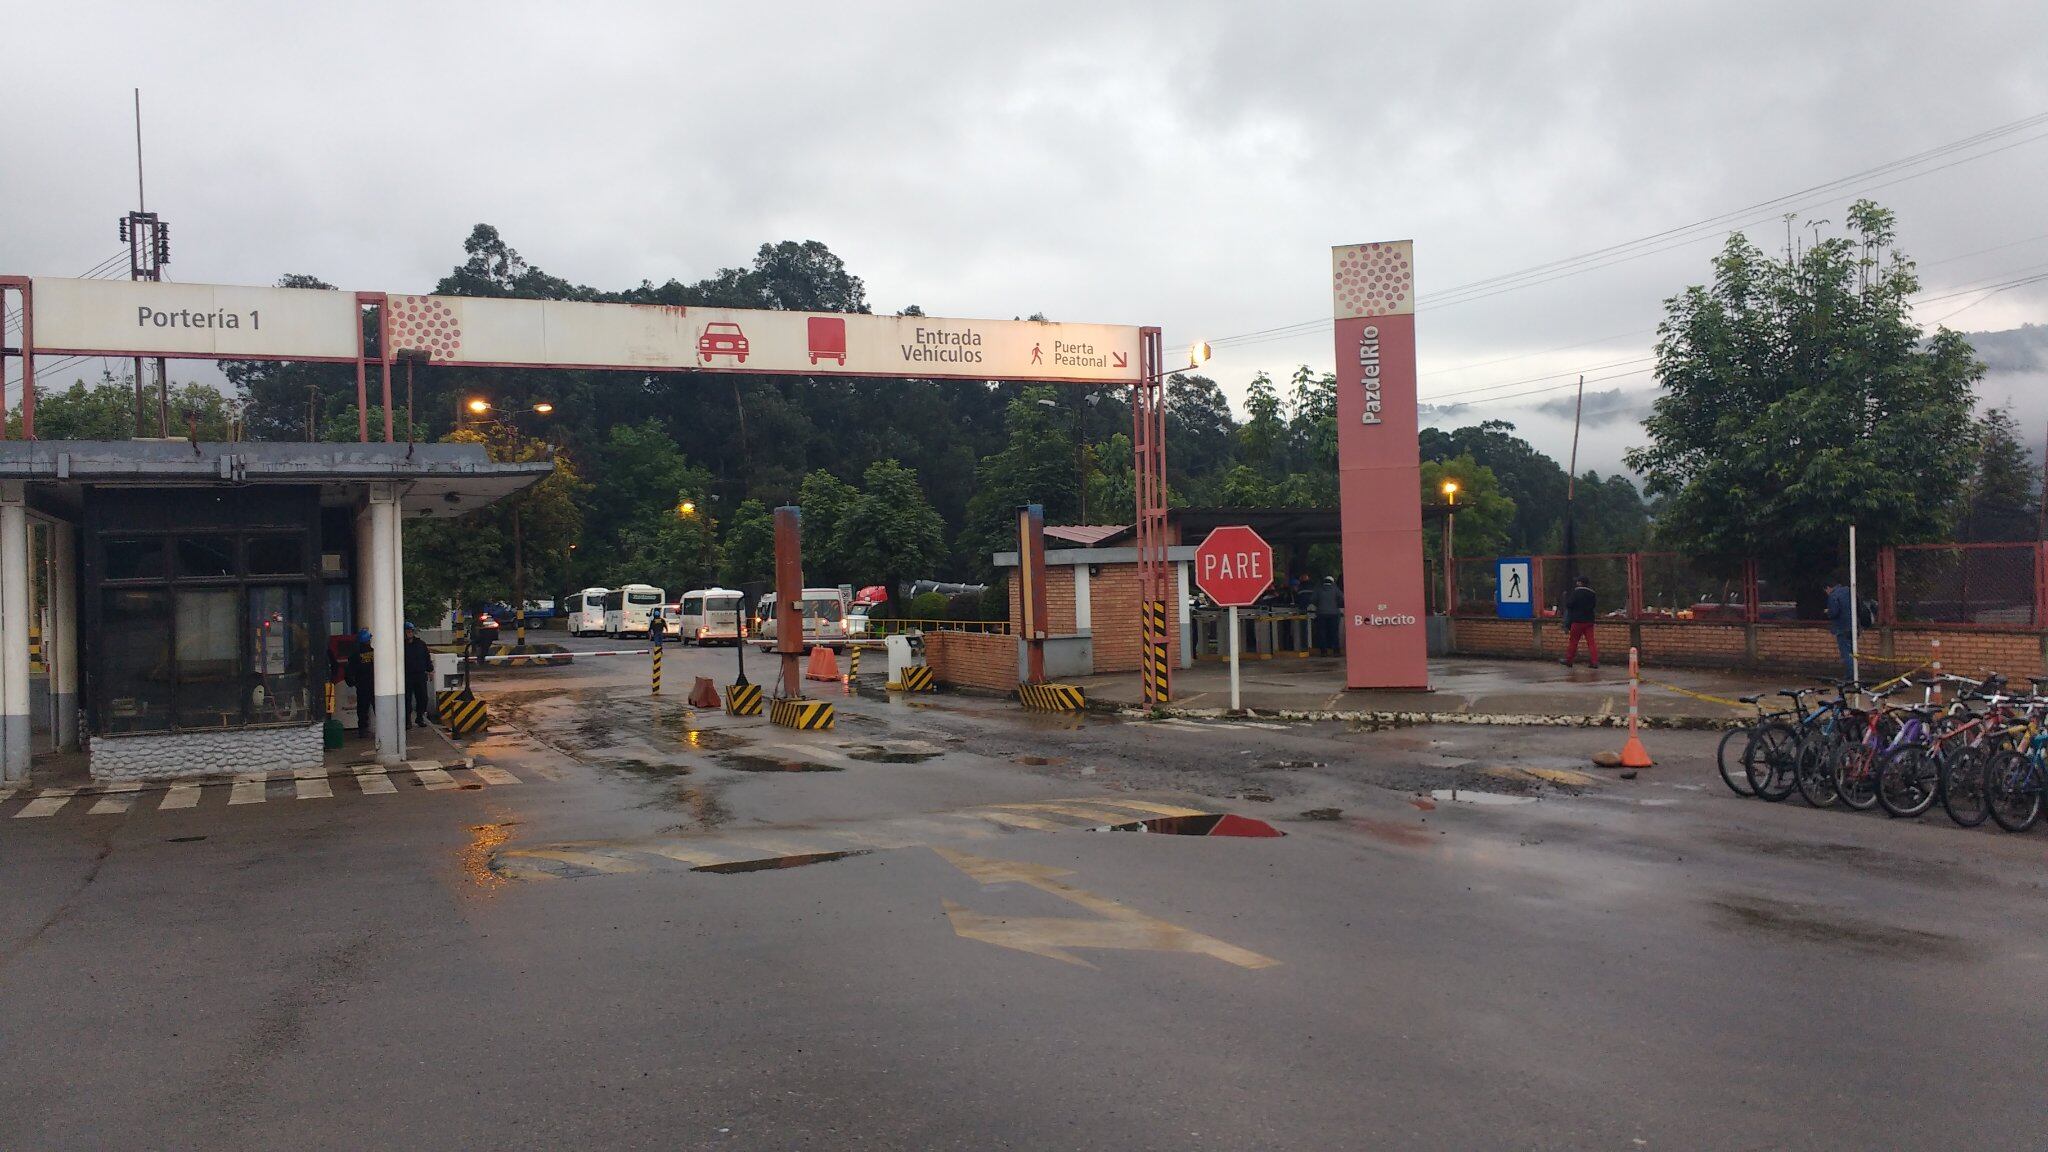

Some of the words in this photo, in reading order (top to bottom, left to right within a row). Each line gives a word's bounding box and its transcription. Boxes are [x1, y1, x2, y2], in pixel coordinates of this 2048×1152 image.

[138, 306, 239, 329] Portería
[249, 310, 259, 330] 1
[916, 327, 982, 346] Entrada
[901, 344, 983, 363] Vehículos
[1054, 340, 1094, 354] Puerta
[1054, 352, 1107, 368] Peatonal
[1204, 551, 1263, 581] PARE
